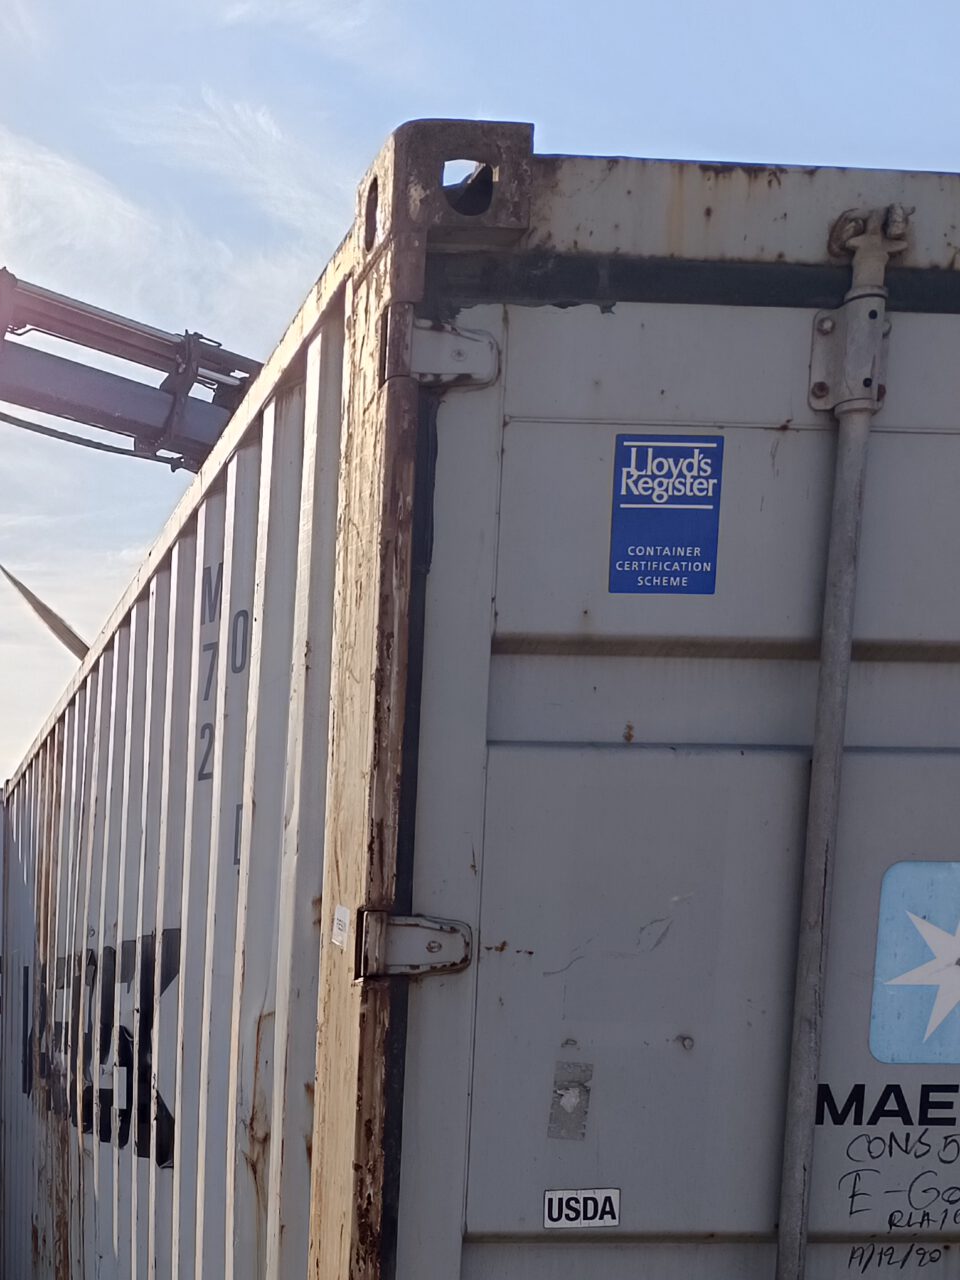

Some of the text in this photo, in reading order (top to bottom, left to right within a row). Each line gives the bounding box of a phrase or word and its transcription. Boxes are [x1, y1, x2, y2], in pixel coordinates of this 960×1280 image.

[630, 447, 712, 479] Lloyd's
[620, 467, 717, 503] Register
[628, 546, 701, 557] CONTAINER
[616, 561, 711, 572] CERTIFICATION
[637, 576, 688, 587] SCHEME
[815, 1083, 960, 1126] MAE
[547, 1196, 617, 1222] USDA
